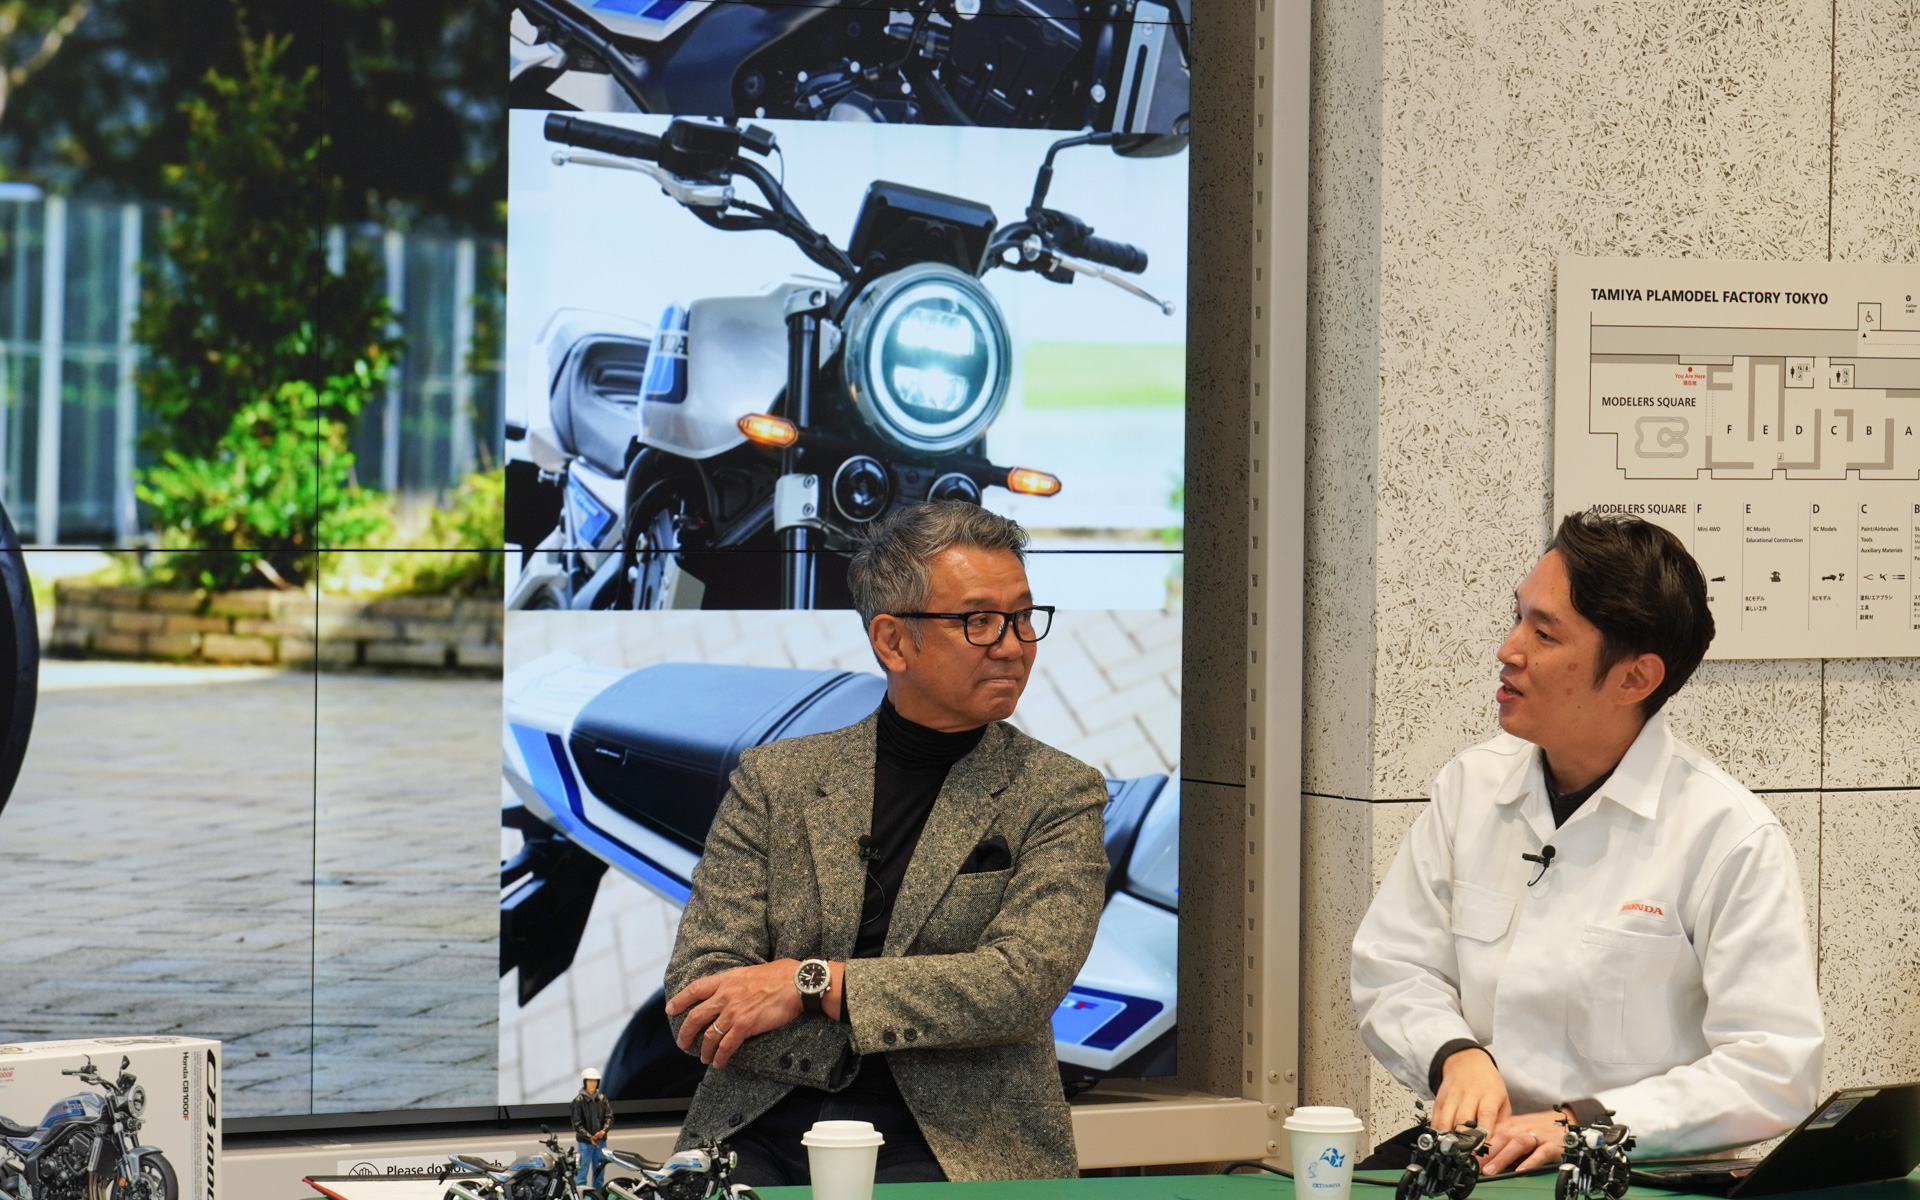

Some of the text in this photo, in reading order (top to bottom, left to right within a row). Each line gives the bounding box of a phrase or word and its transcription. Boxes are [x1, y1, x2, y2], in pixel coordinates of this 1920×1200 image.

[1590, 288, 1829, 305] TAMIYA PLAMODEL FACTORY TOKYO
[1601, 396, 1697, 409] MODELERS SQUARE
[1726, 424, 1733, 435] F
[1762, 425, 1769, 435] E
[1795, 425, 1803, 436] D
[1830, 425, 1837, 436] C
[1866, 425, 1873, 436] B
[1904, 425, 1913, 436] A
[1592, 503, 1687, 515] MODELERS SQUARE
[1696, 503, 1703, 514] F
[1745, 503, 1752, 514] E
[1812, 503, 1820, 514] D
[1860, 503, 1868, 514] C
[1914, 503, 1920, 514] B
[1621, 903, 1665, 916] HONDA
[182, 1080, 190, 1121] CB1000F
[386, 1165, 424, 1175] Please
[427, 1163, 443, 1175] do
